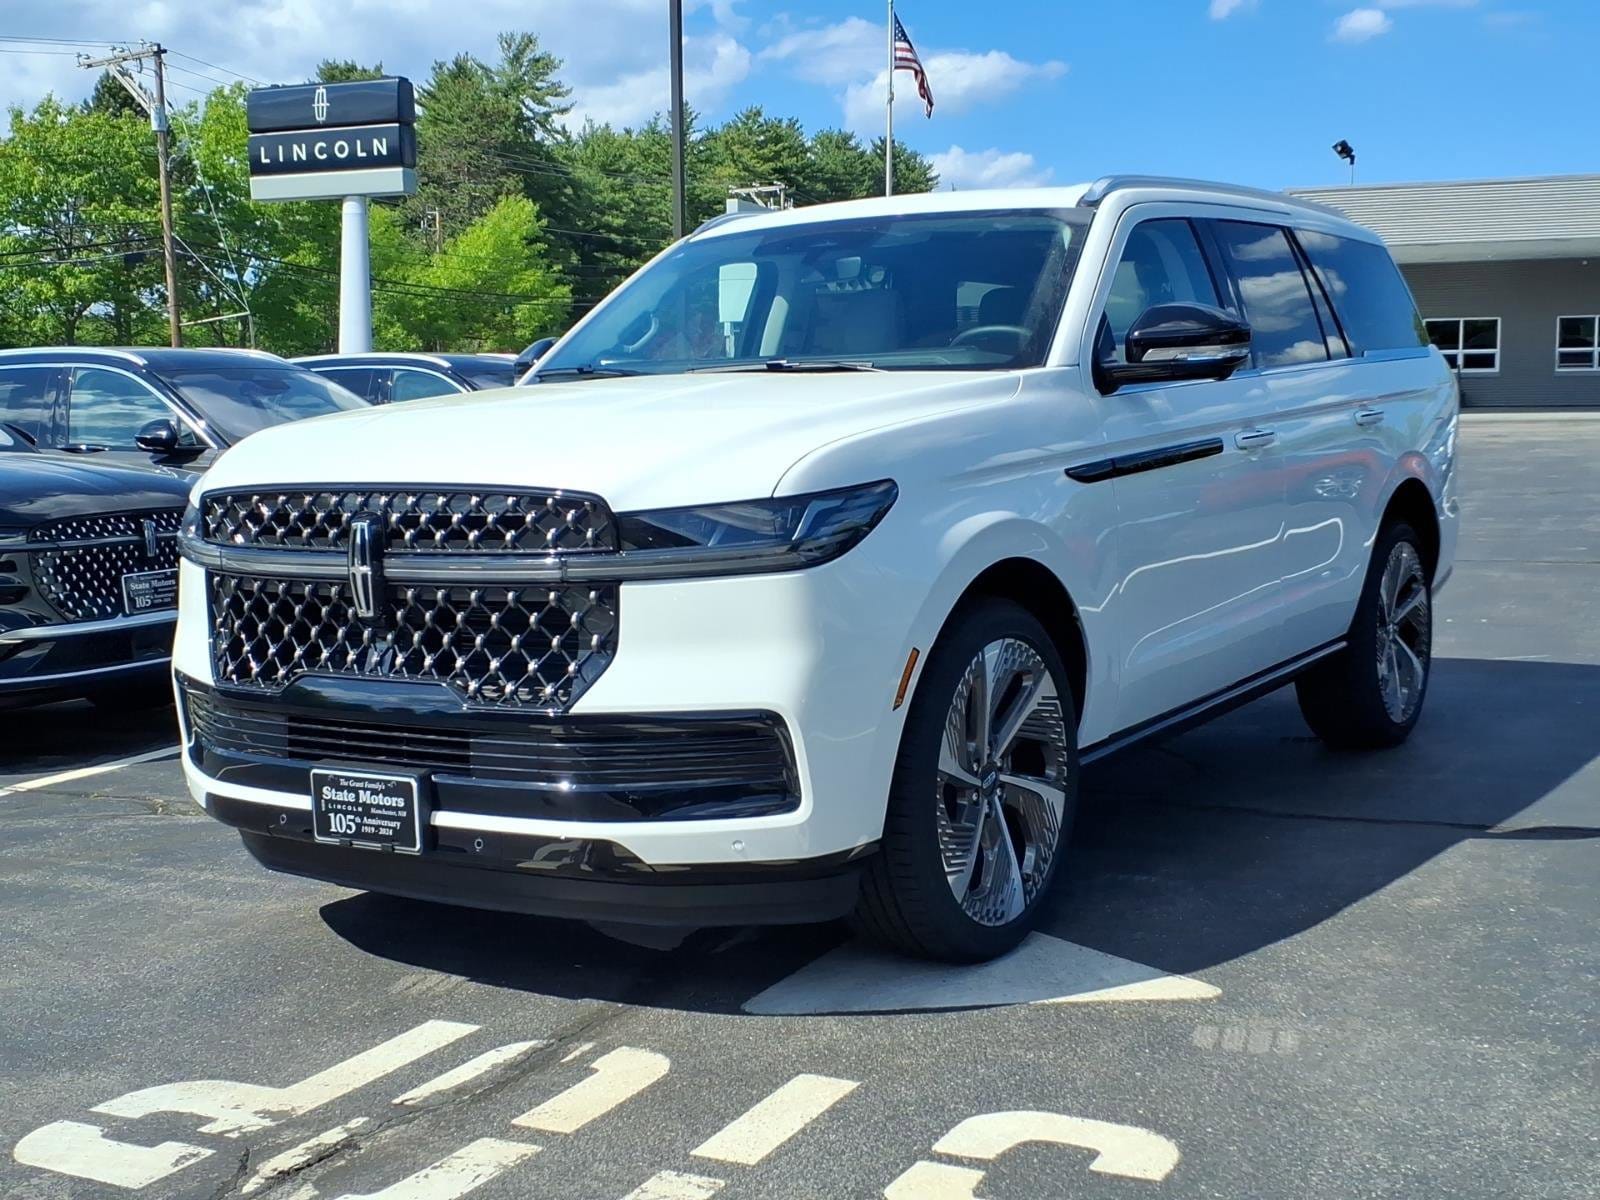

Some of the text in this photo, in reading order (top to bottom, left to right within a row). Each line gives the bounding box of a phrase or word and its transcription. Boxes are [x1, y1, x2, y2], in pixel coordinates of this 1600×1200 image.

[260, 137, 388, 164] LINCOLN
[130, 582, 150, 590] State
[322, 786, 405, 808] State Motors
[328, 803, 363, 812] LINCOLN
[362, 816, 401, 830] Anniversary
